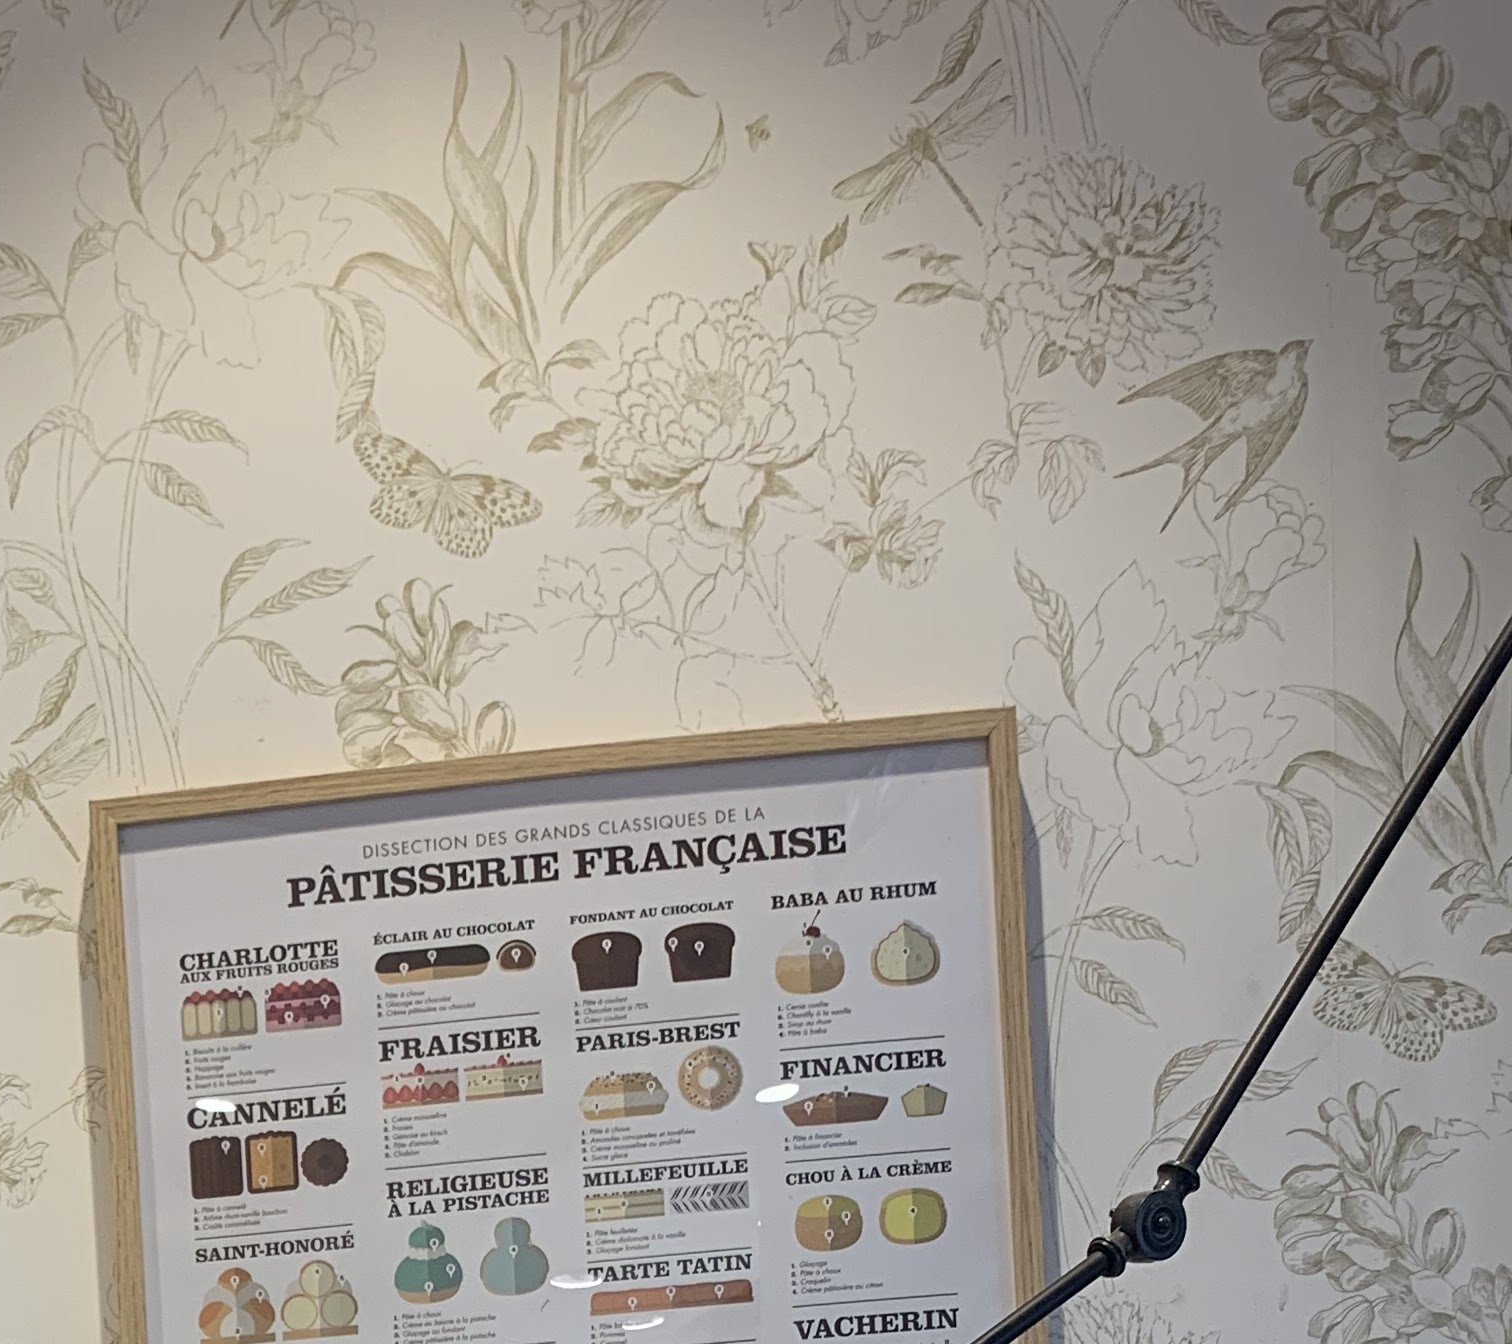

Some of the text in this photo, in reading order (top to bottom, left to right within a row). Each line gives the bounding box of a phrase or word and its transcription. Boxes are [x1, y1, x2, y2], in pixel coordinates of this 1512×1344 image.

[363, 807, 765, 859] DISSECTION DES GRANDS CLASSIQUES DE LA
[287, 824, 846, 907] PÂTISSERIE FRANÇAISE
[771, 881, 937, 910] BABA AU RHUM
[570, 900, 733, 925] FONDANT AU CHOCOLAT
[373, 919, 535, 945] ÉCLAIR AU CHOCOLAT
[180, 940, 338, 971] CHARLOTTE
[180, 958, 339, 984] AUX FRUITS ROUGES
[378, 1026, 541, 1062] FRAISIER
[576, 1022, 740, 1053] PARIS-BREST
[780, 1049, 946, 1080] FINANCIER
[188, 1087, 346, 1129] CANNELÉ
[387, 1167, 548, 1199] RELIGIEUSE
[583, 1159, 748, 1188] MILLEFEUILLE
[786, 1159, 952, 1185] CHOU À LA CRÈME
[387, 1189, 549, 1218] À LA PISTACHE
[195, 1230, 354, 1263] SAINT-HONORÉ
[588, 1254, 752, 1282] TARTE TATIN
[793, 1308, 959, 1340] VACHERIN
